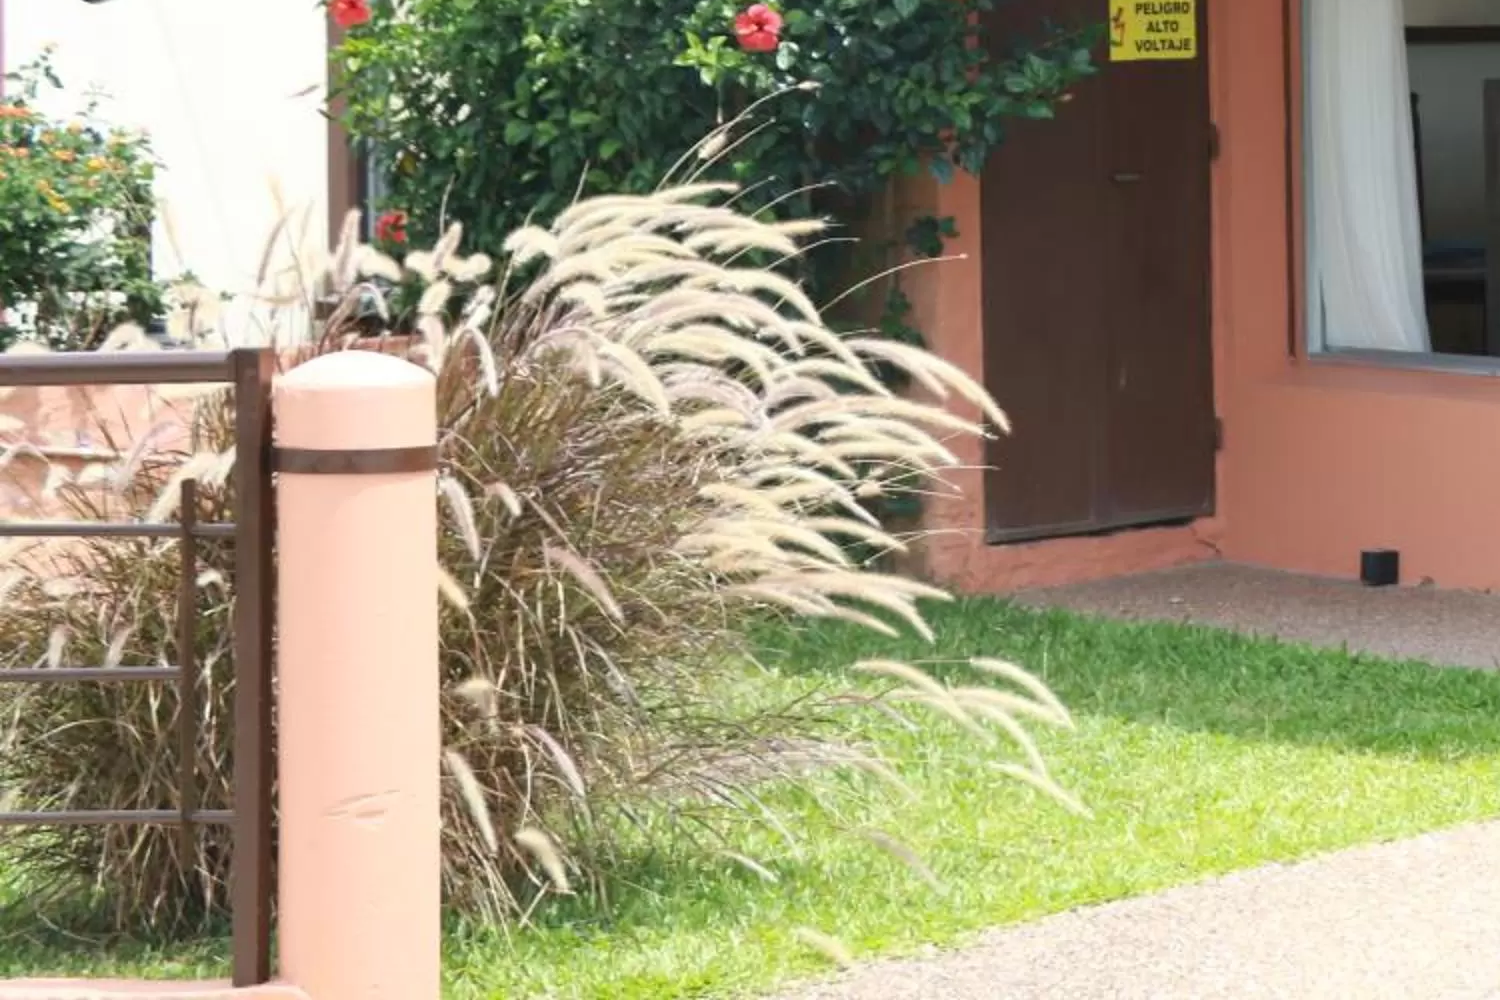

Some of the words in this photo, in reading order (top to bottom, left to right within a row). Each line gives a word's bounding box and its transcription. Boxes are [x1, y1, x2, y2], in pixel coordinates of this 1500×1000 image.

[1135, 2, 1190, 15] PELIGRO
[1145, 19, 1180, 33] ALTO
[1135, 38, 1192, 53] VOLTAJE
